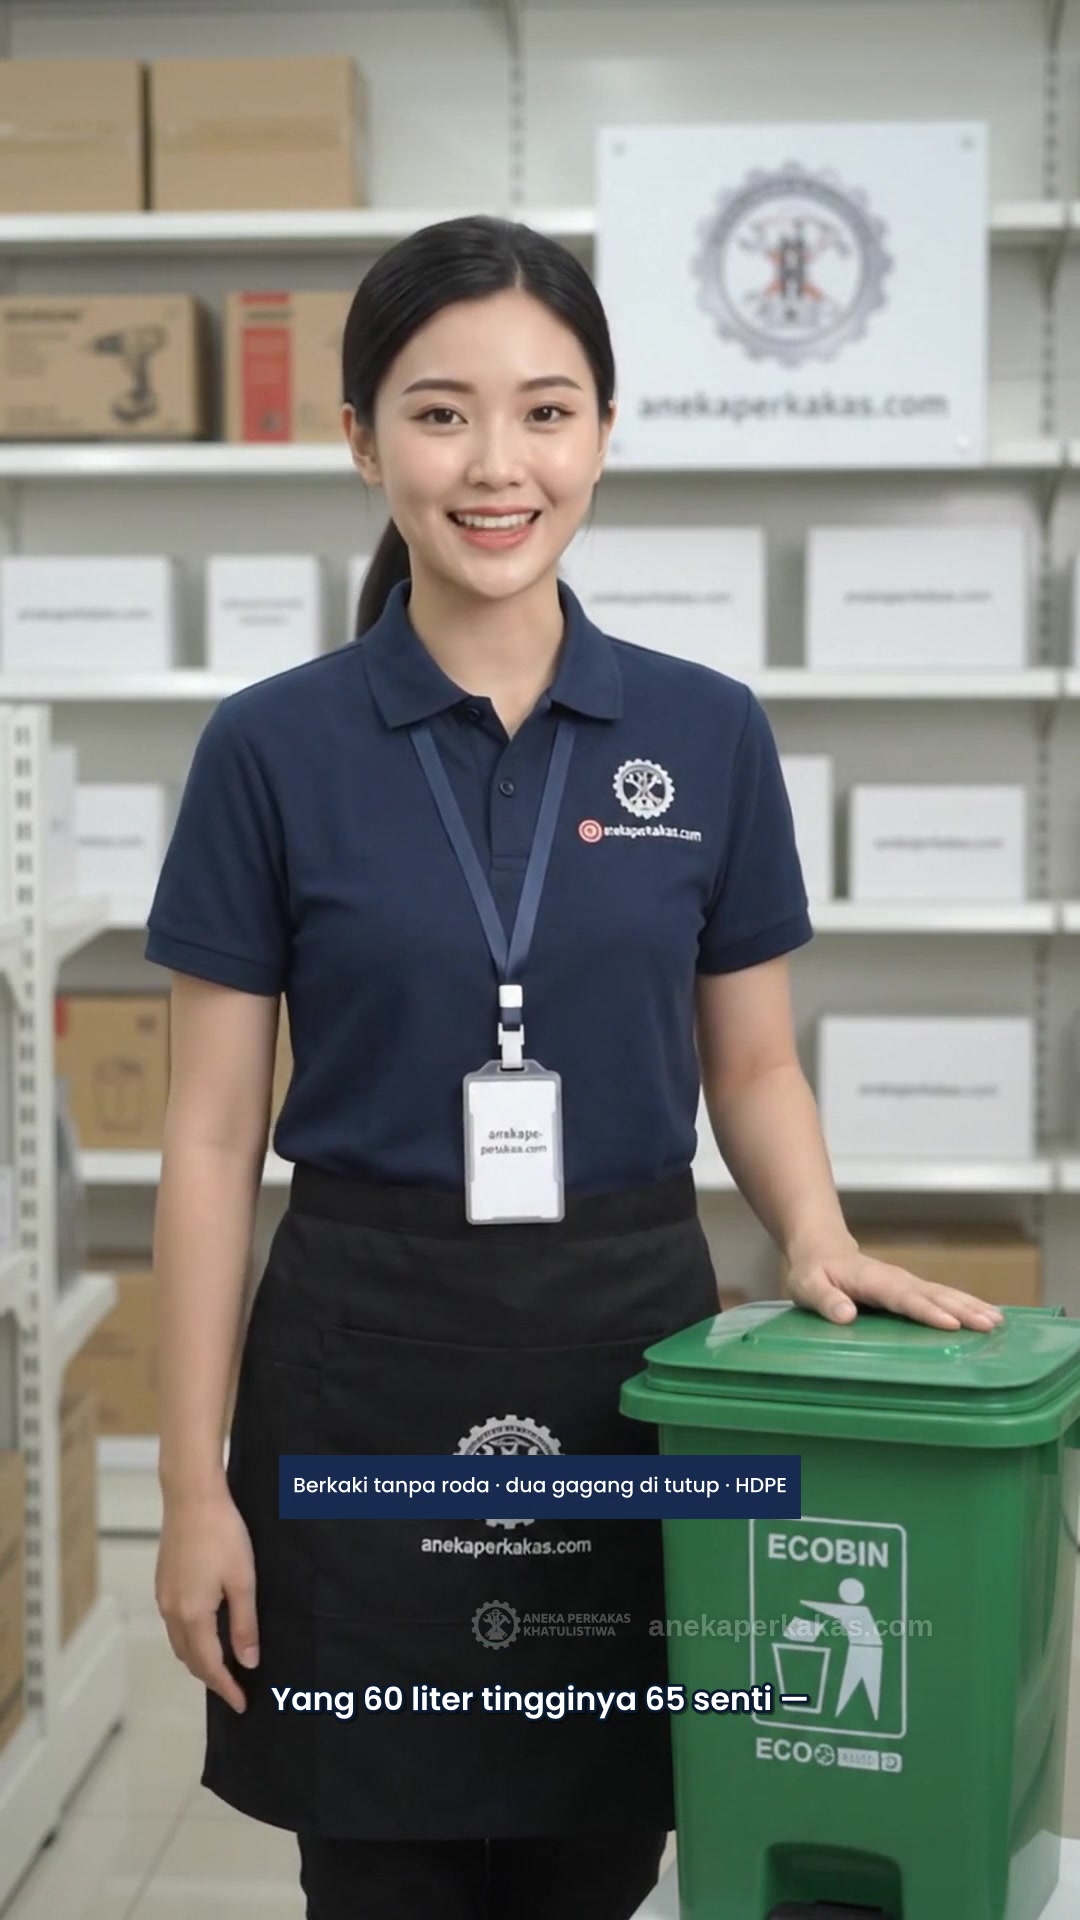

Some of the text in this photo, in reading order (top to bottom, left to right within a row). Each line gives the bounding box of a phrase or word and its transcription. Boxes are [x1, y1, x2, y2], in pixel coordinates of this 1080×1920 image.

[638, 390, 950, 425] anekaperkakas.com
[421, 1536, 592, 1559] anekaperkakas.com
[767, 1532, 890, 1569] ECOBIN
[755, 1737, 813, 1763] ECO
